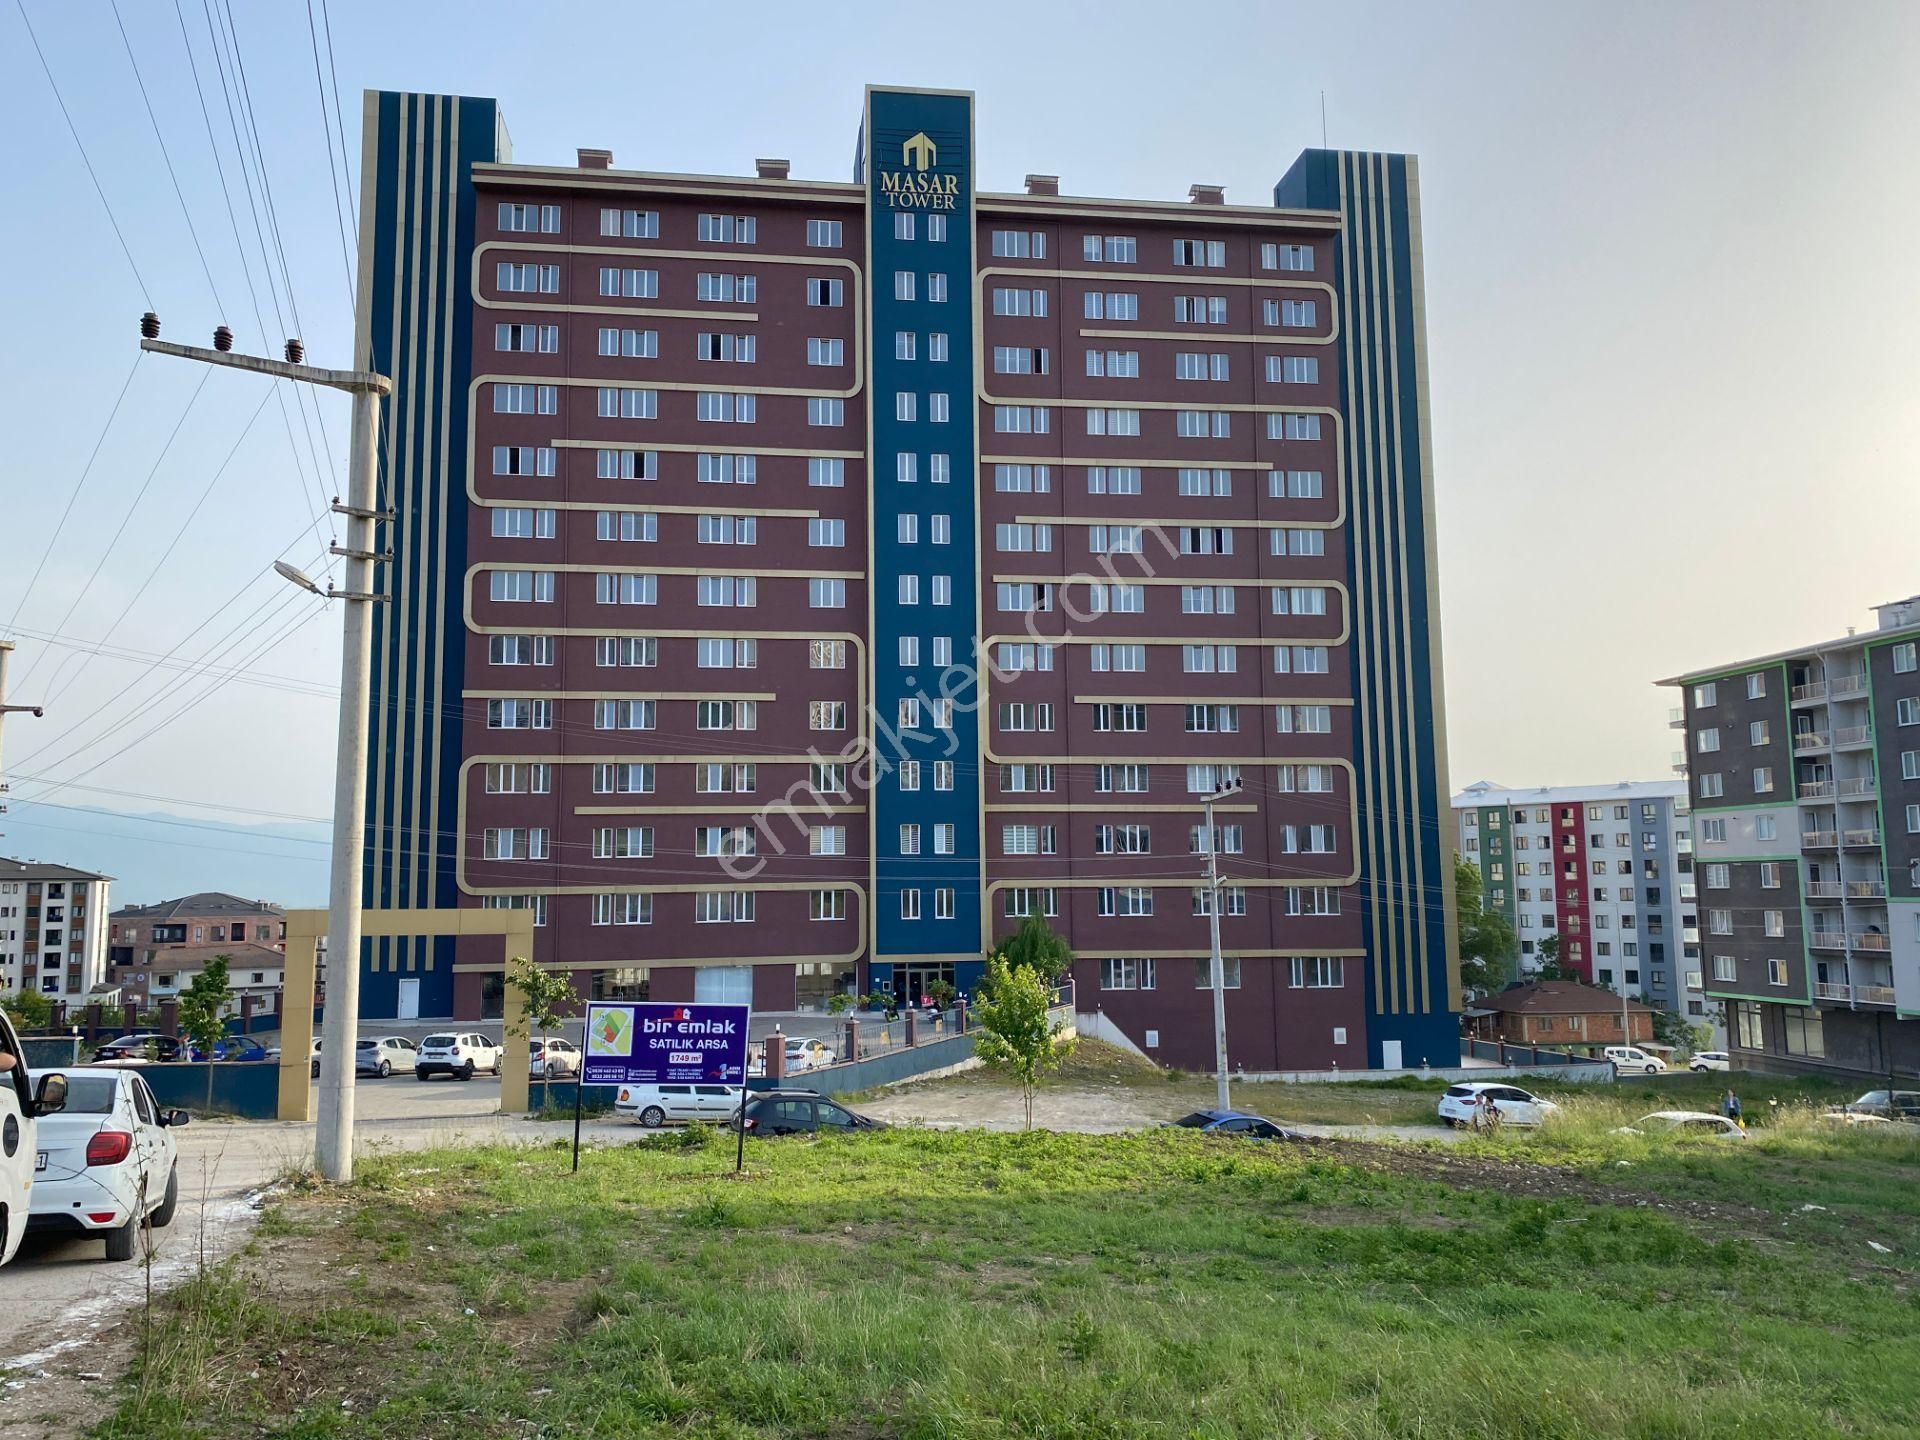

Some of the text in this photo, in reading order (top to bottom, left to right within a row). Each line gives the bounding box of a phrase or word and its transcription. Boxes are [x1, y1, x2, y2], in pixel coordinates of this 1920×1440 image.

[880, 172, 959, 194] MASAR
[886, 192, 956, 209] TOWER
[644, 1018, 736, 1034] bir emlak
[649, 1039, 728, 1049] SATILIK ARSA
